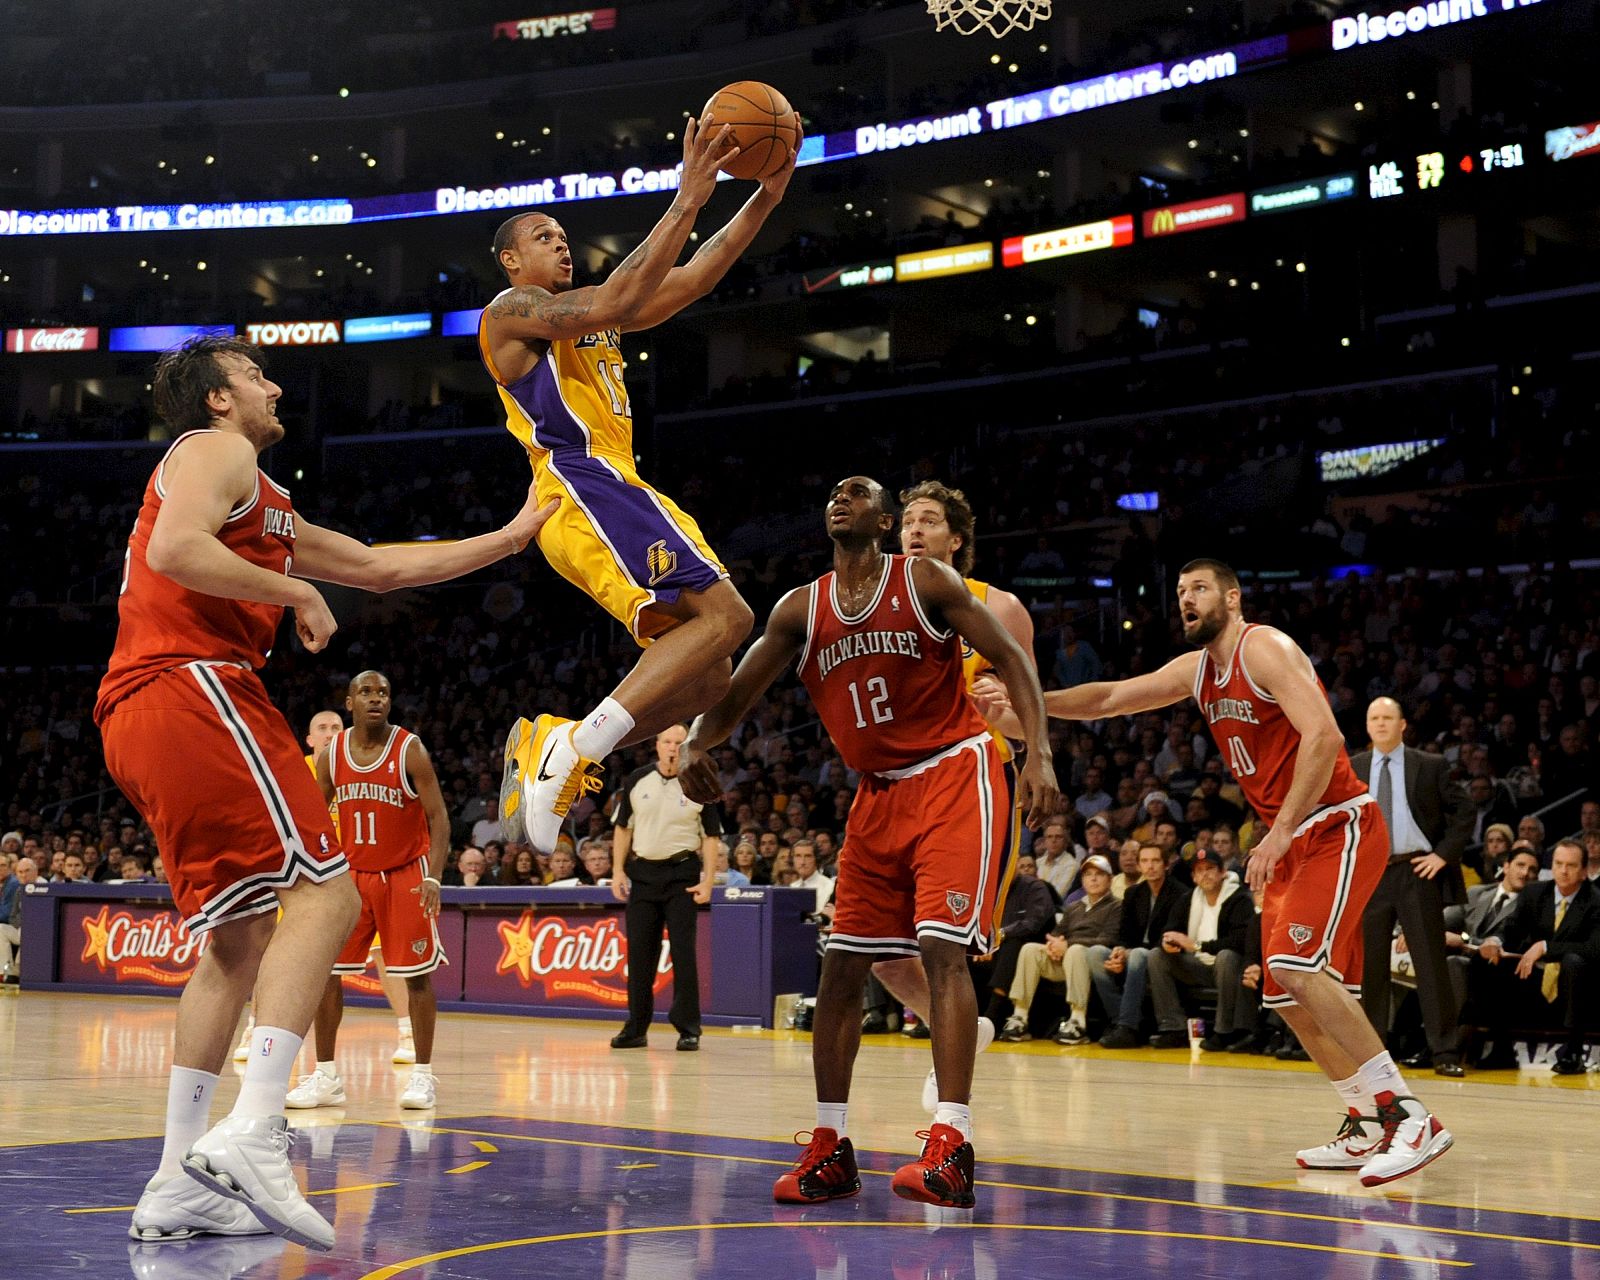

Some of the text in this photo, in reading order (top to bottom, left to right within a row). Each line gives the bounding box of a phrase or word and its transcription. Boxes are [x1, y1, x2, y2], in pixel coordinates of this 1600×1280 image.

[855, 51, 1237, 154] Discount Tire Centers.com
[1480, 143, 1524, 172] 7:51
[436, 178, 556, 213] Discount
[560, 173, 616, 199] Tire
[0, 203, 353, 235] Discount Tire Centers.com
[247, 322, 340, 344] TOYOTA
[817, 630, 922, 681] MILWAUKEE
[848, 676, 894, 729] 12
[336, 782, 405, 809] ILWAUKEE
[353, 811, 377, 845] 11
[107, 916, 175, 962] Carl's
[531, 922, 625, 975] Carl's
